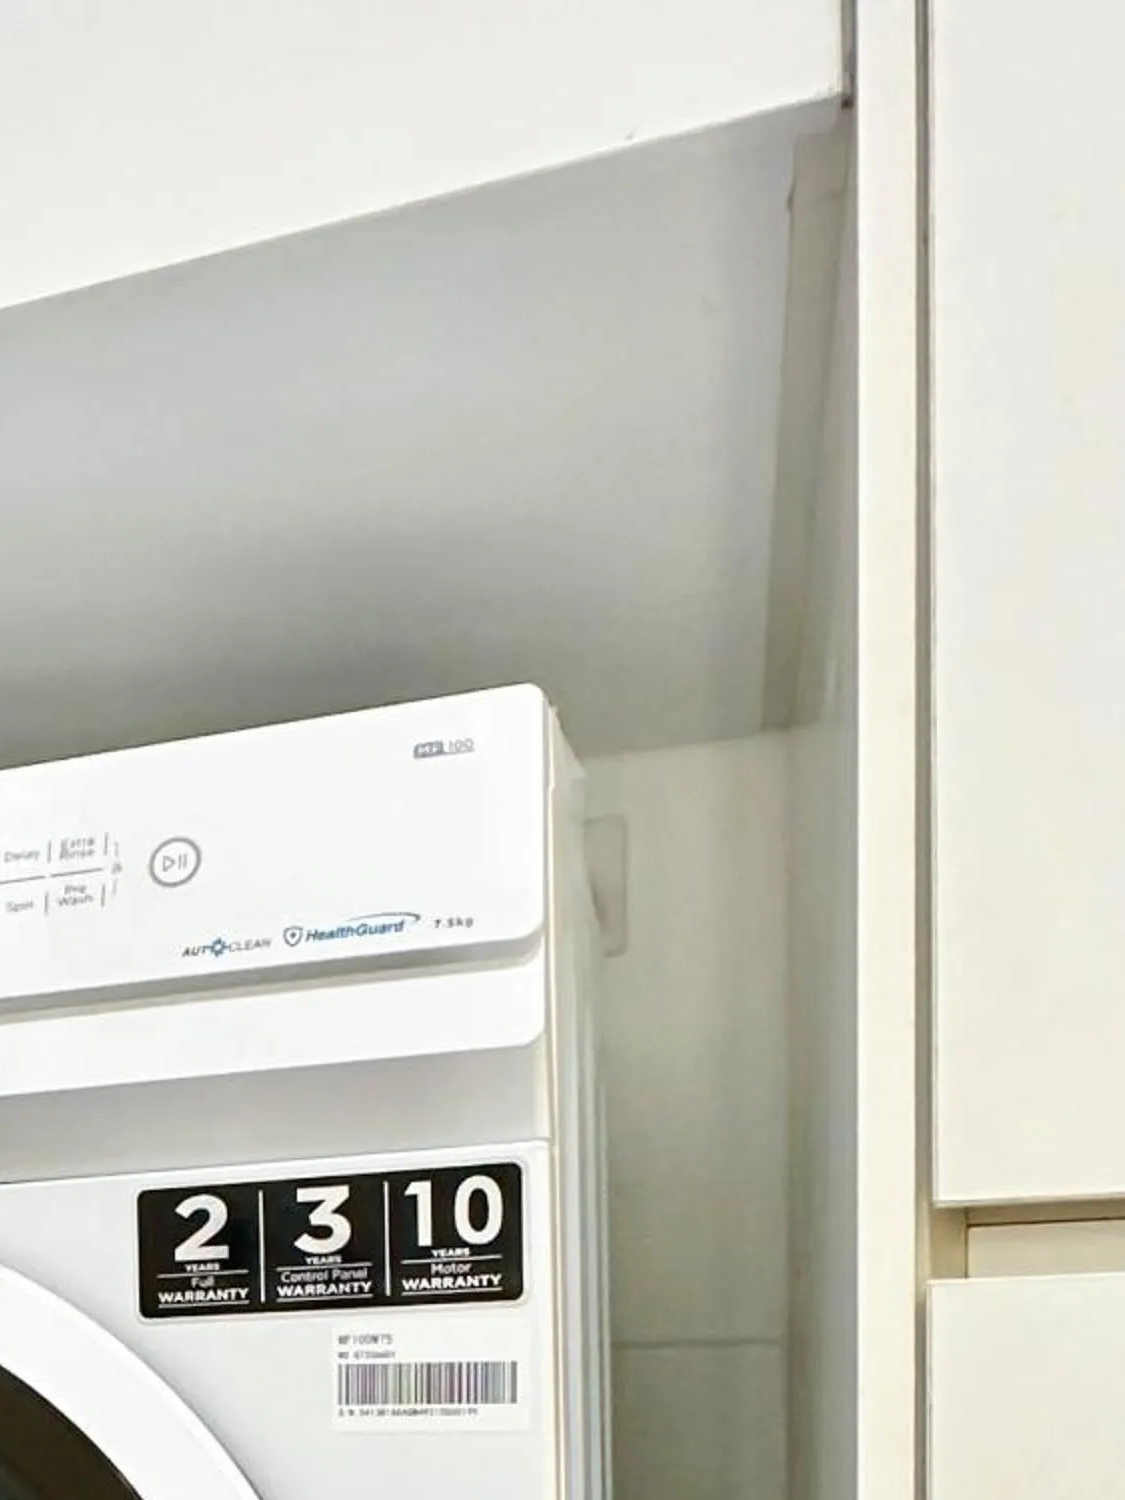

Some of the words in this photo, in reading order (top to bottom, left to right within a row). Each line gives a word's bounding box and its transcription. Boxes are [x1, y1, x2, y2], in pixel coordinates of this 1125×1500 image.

[4, 850, 40, 863] Delay
[6, 900, 34, 913] Spin
[58, 894, 94, 907] Wash
[305, 919, 406, 943] HealthGuard
[403, 1175, 504, 1247] 10
[293, 1184, 352, 1254] 3
[174, 1194, 229, 1262] 2
[305, 1255, 343, 1265] YEARS
[431, 1247, 471, 1258] YEARS
[185, 1262, 220, 1272] YEARS
[431, 1261, 471, 1275] Motor
[191, 1276, 215, 1289] Full
[281, 1268, 328, 1283] Control
[332, 1267, 368, 1280] Panel
[402, 1274, 502, 1291] WARRANTY
[158, 1287, 249, 1303] WARRANTY
[277, 1281, 372, 1297] WARRANTY
